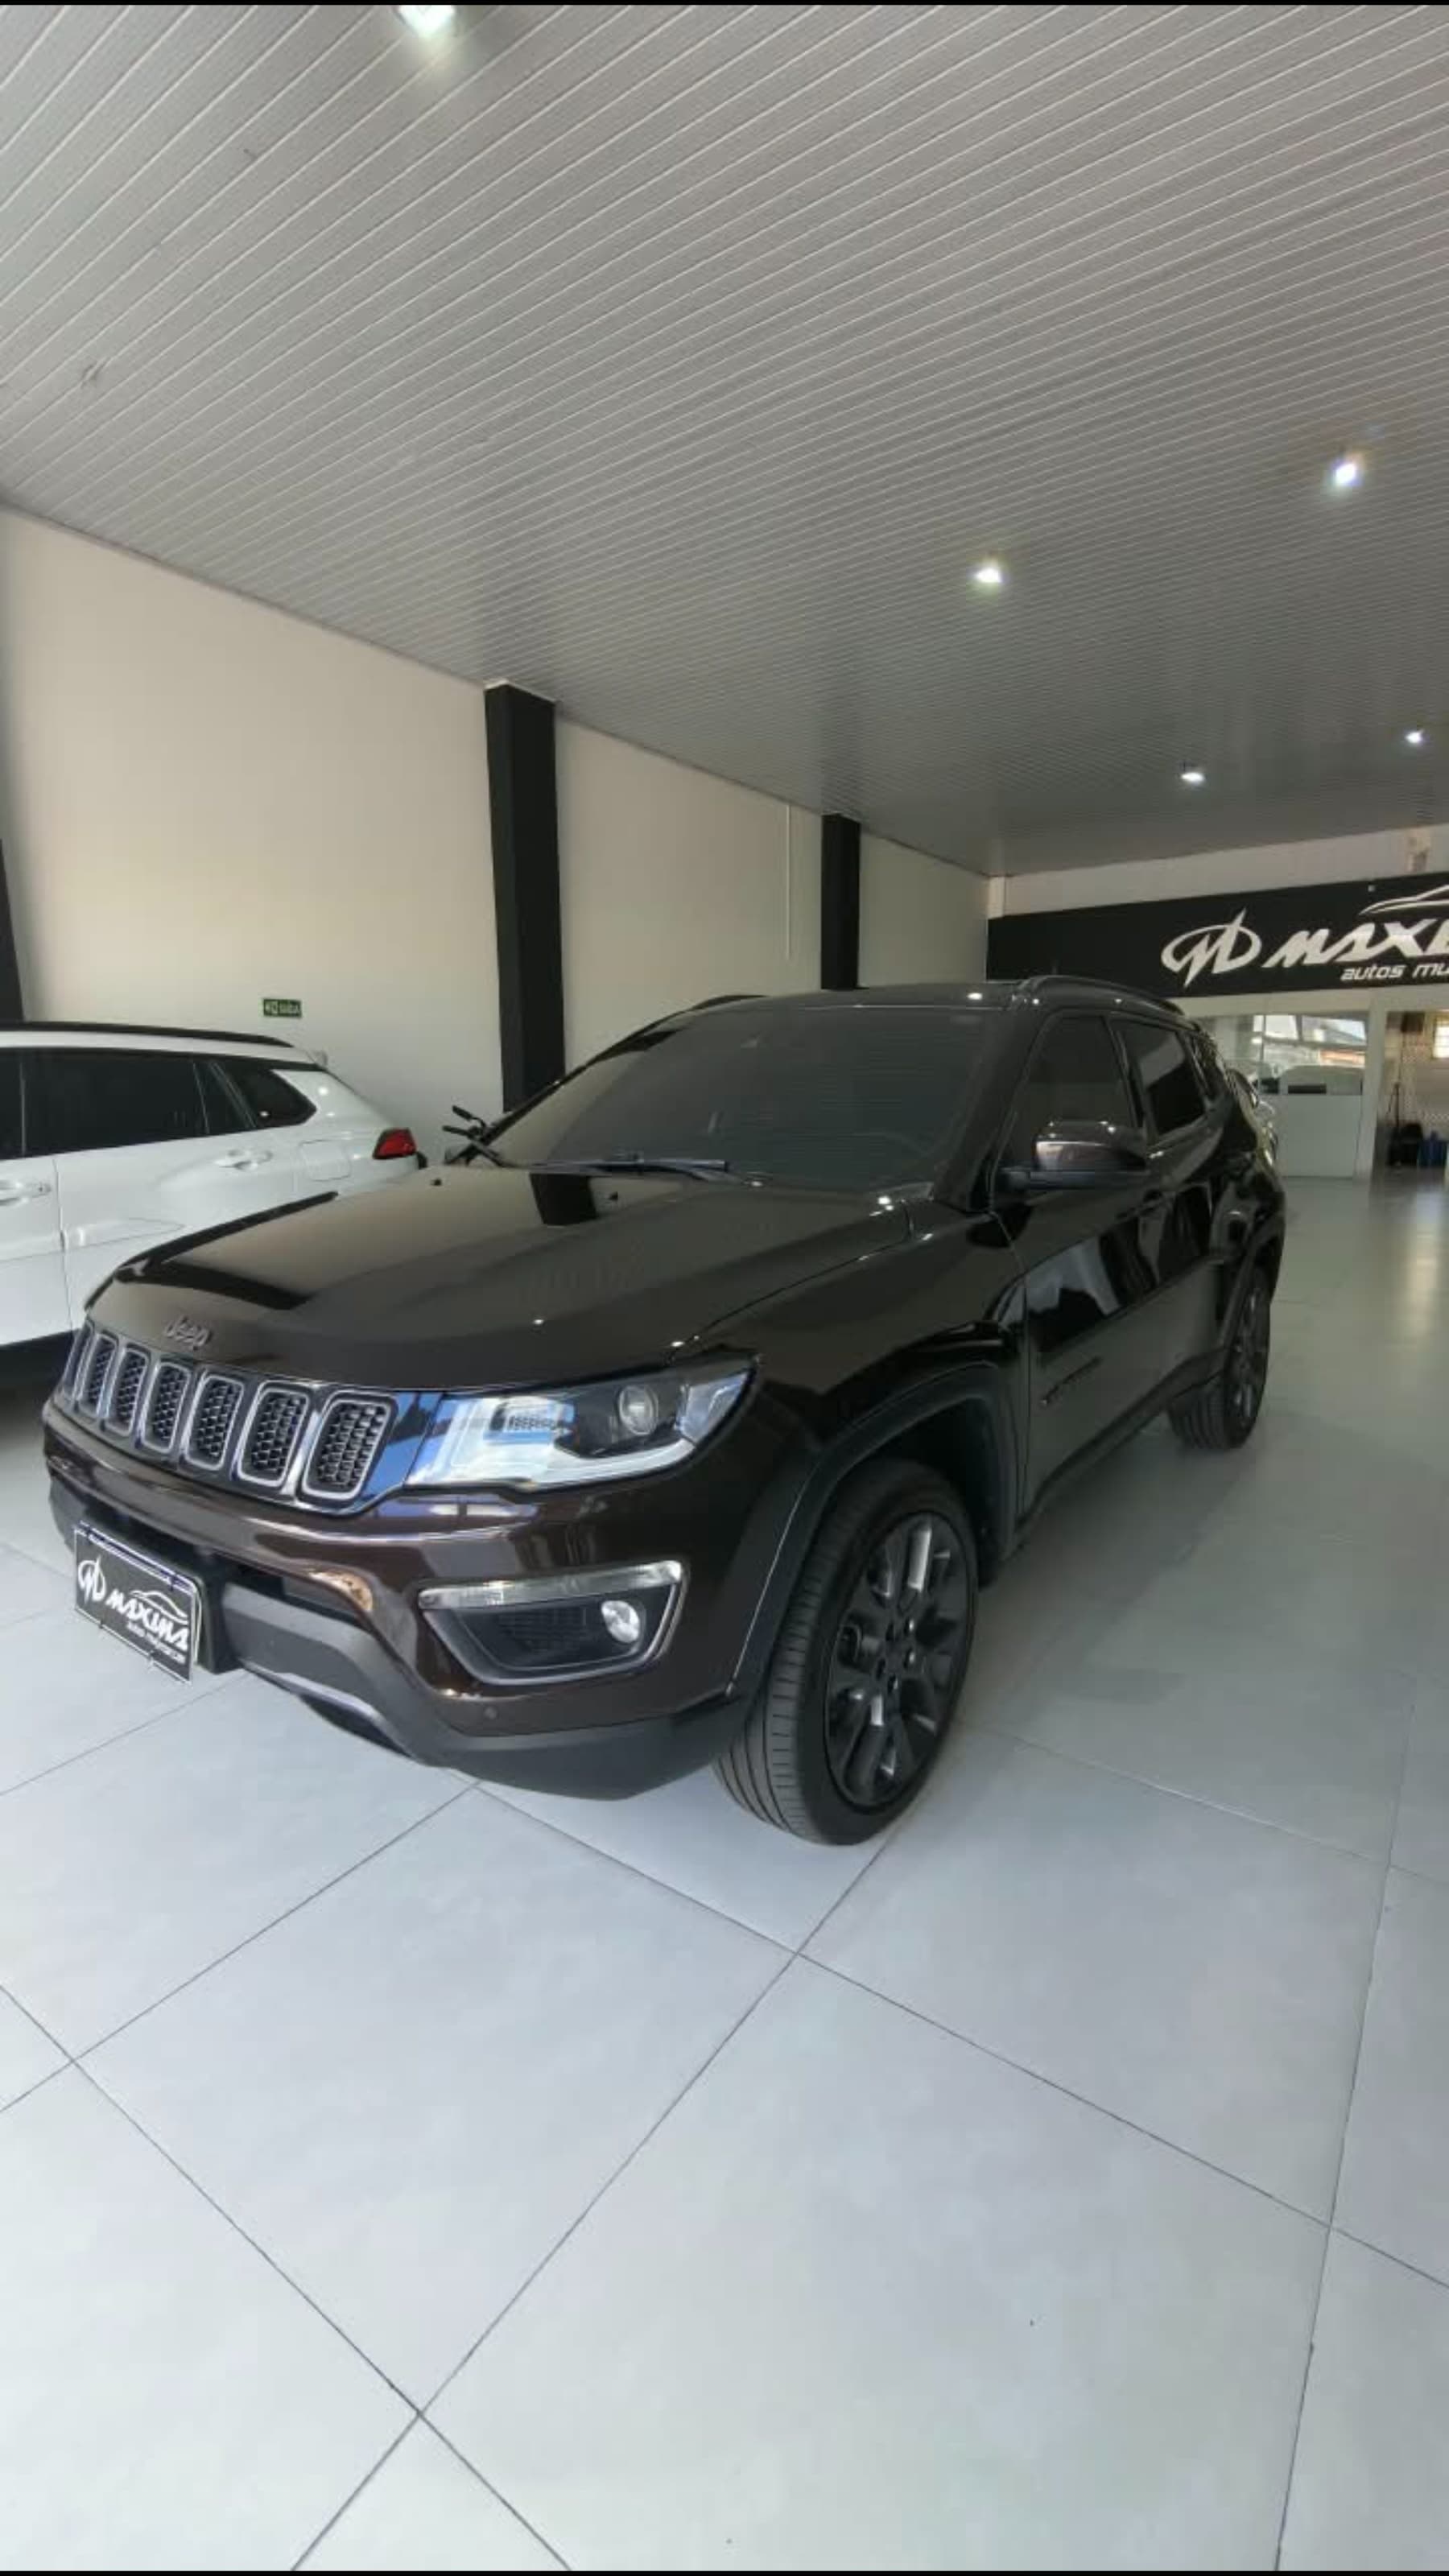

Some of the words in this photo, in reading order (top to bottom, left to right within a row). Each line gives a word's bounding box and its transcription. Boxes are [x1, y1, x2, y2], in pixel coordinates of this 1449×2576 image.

[1340, 964, 1408, 982] autos
[163, 1315, 211, 1352] Jeep
[105, 1588, 190, 1652] MAXIMA
